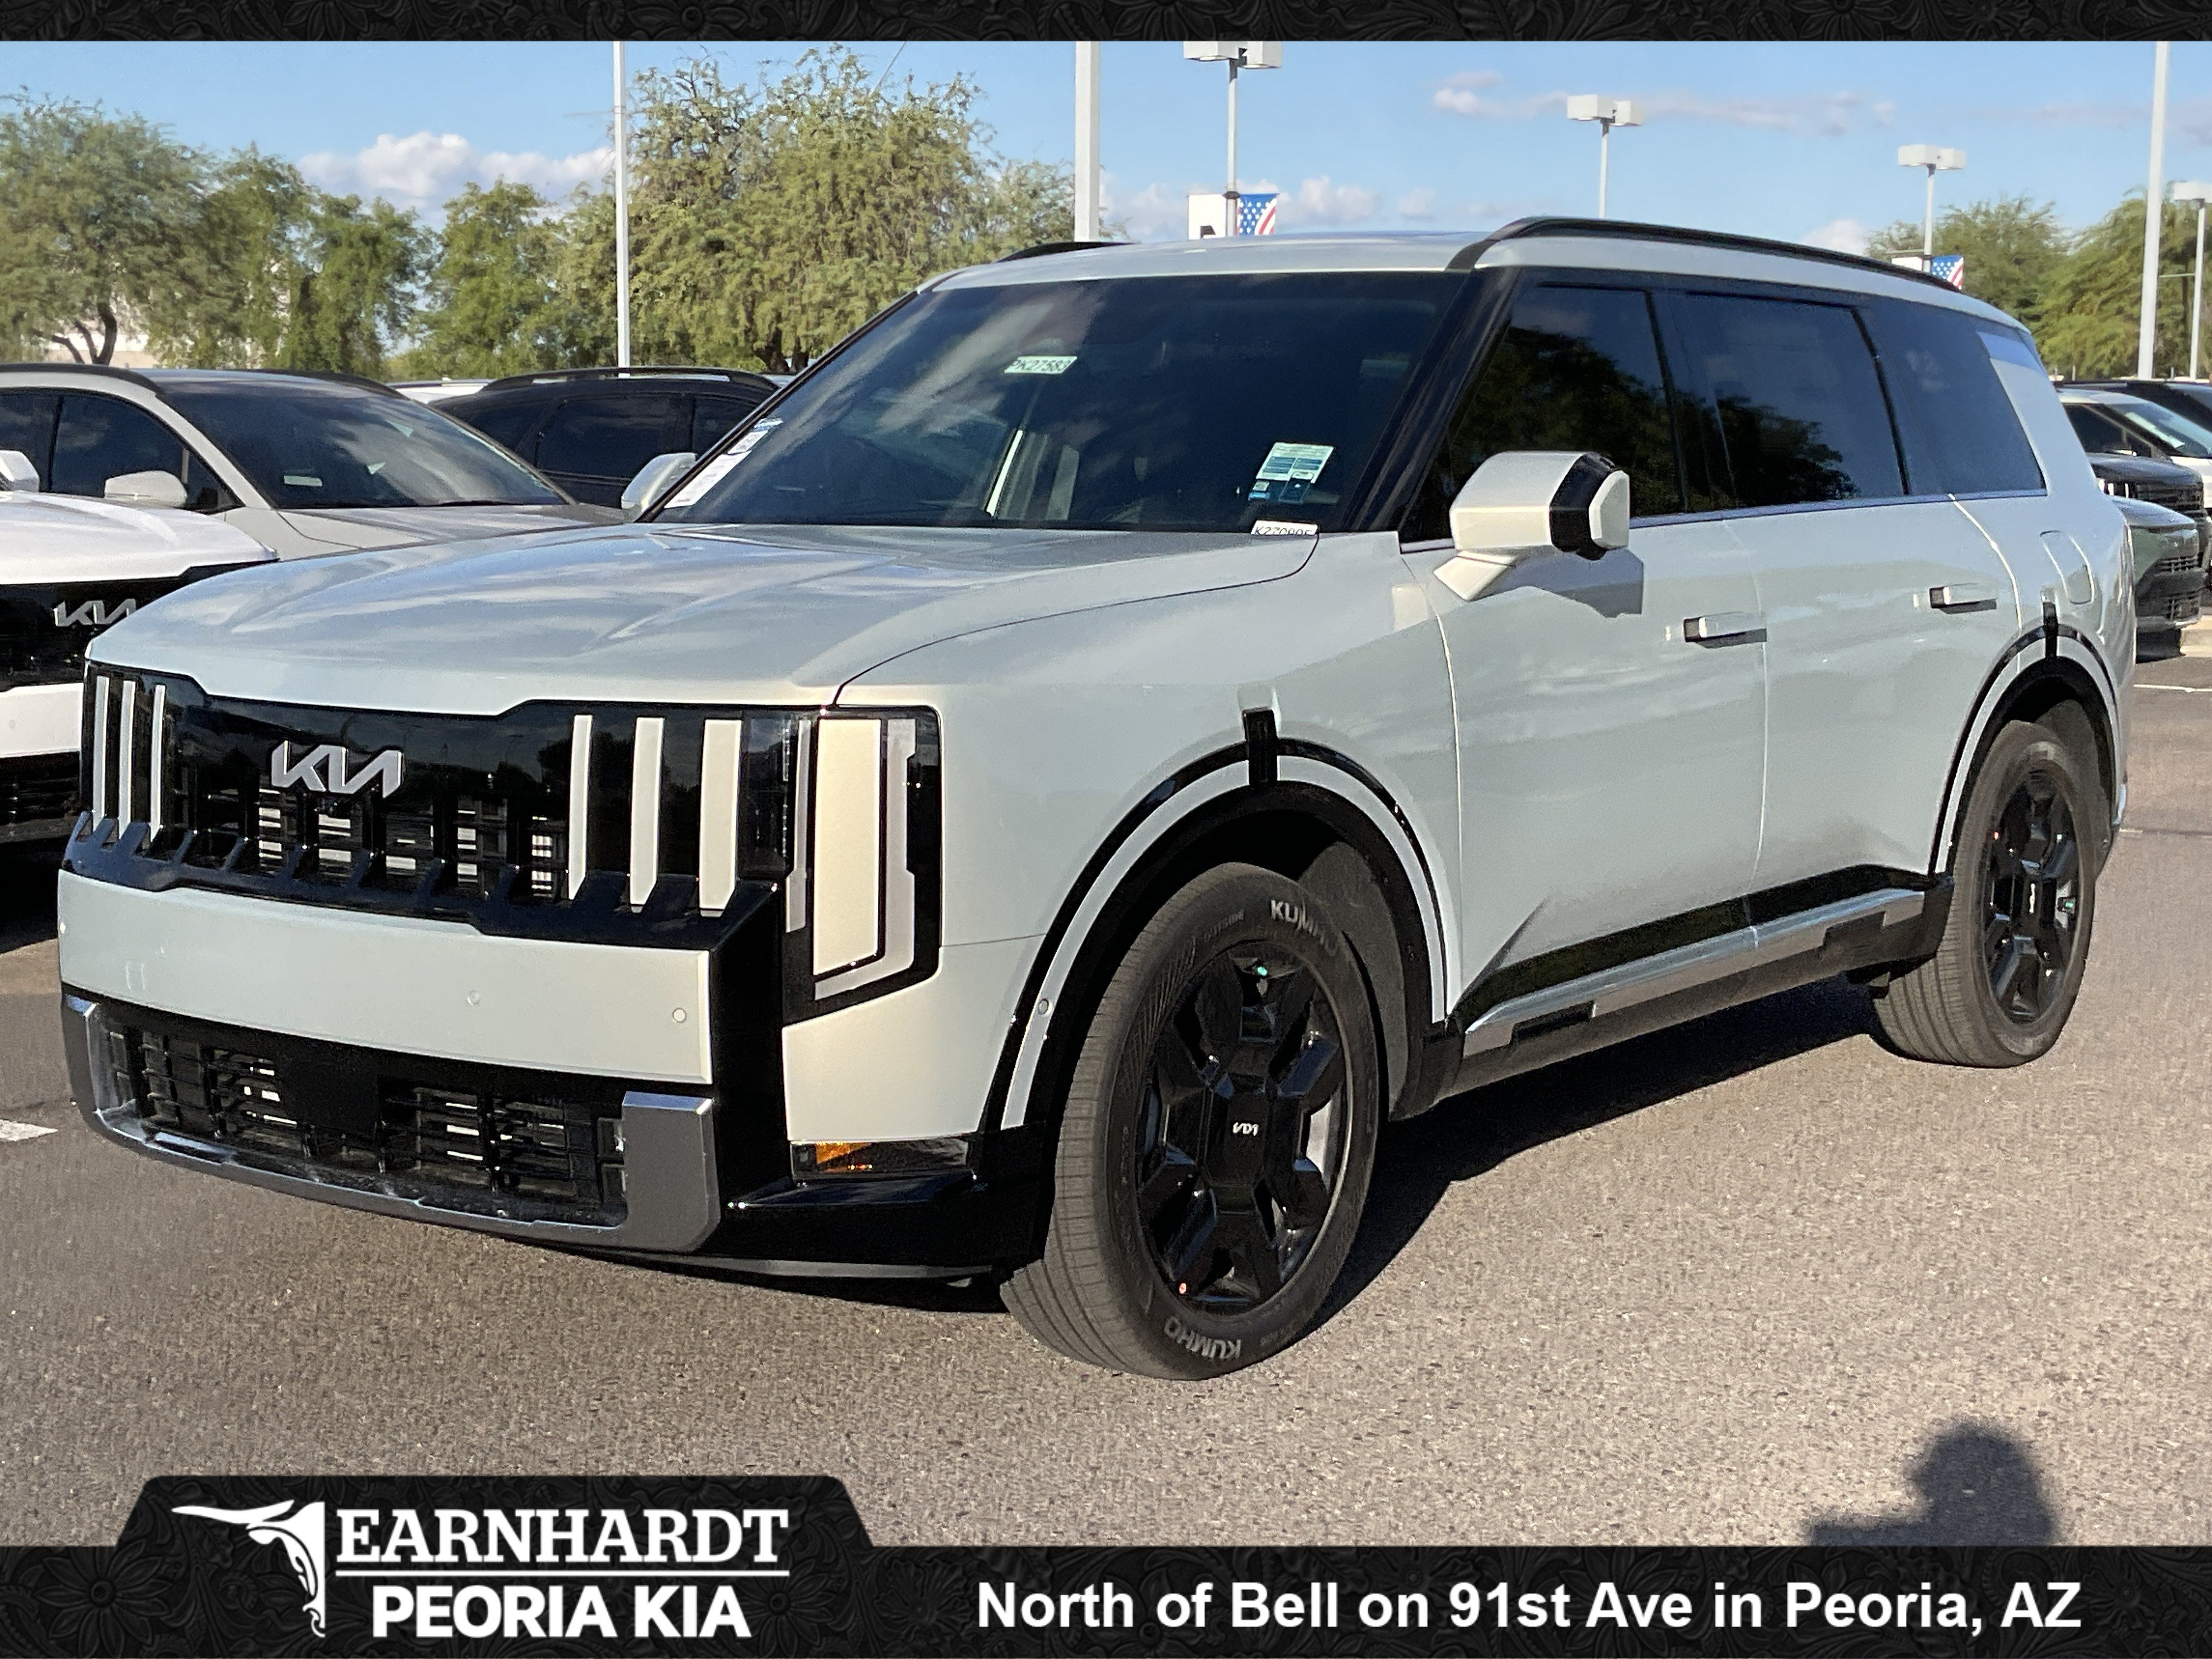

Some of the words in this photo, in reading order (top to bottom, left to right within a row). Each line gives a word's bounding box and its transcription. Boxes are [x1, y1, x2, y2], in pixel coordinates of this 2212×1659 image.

[272, 740, 405, 798] KIA
[1271, 899, 1338, 957] KUMHO
[1164, 1316, 1242, 1359] KUMHO
